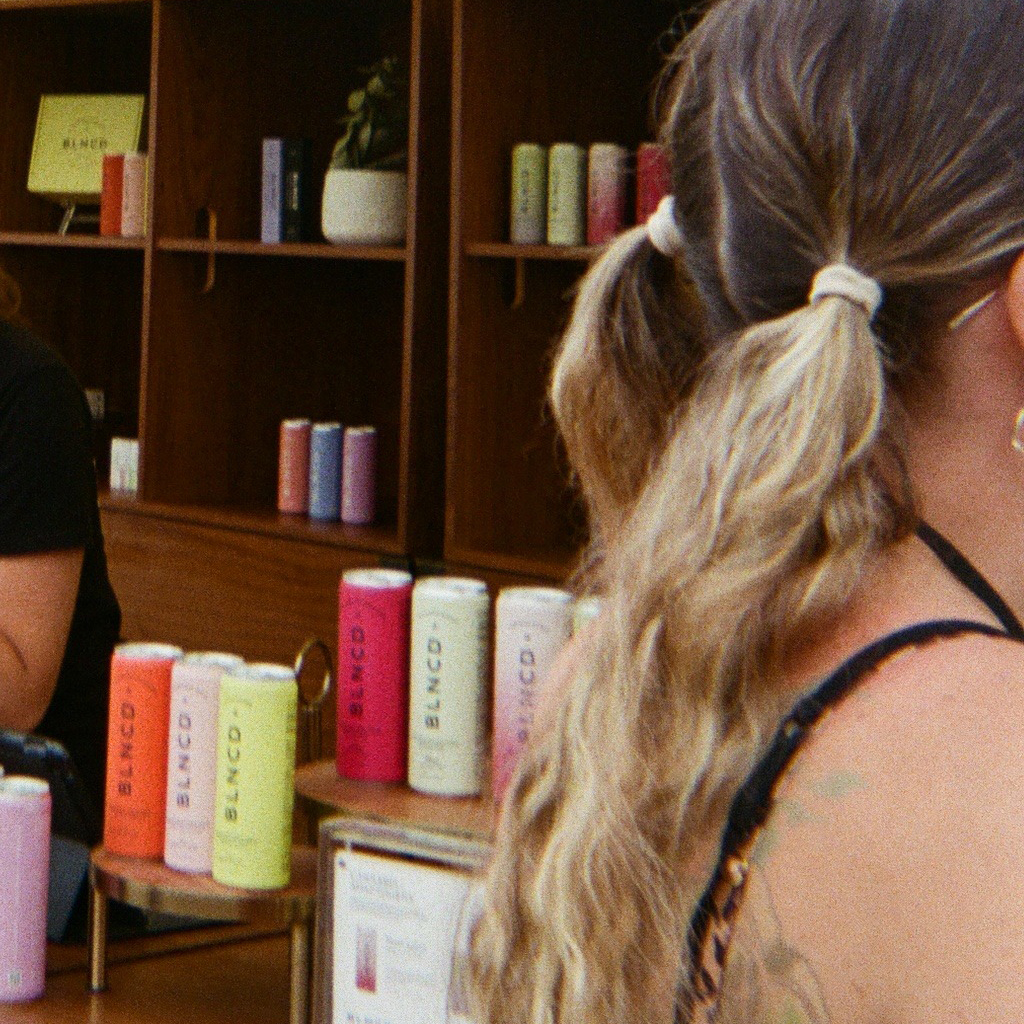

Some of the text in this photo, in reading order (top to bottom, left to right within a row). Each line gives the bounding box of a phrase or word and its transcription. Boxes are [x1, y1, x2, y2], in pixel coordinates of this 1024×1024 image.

[349, 626, 365, 717] BLNCD
[425, 637, 442, 730] BLNCD
[118, 702, 135, 796] BLNCD
[177, 712, 192, 808] BLNCD
[225, 725, 242, 822] BLNCD
